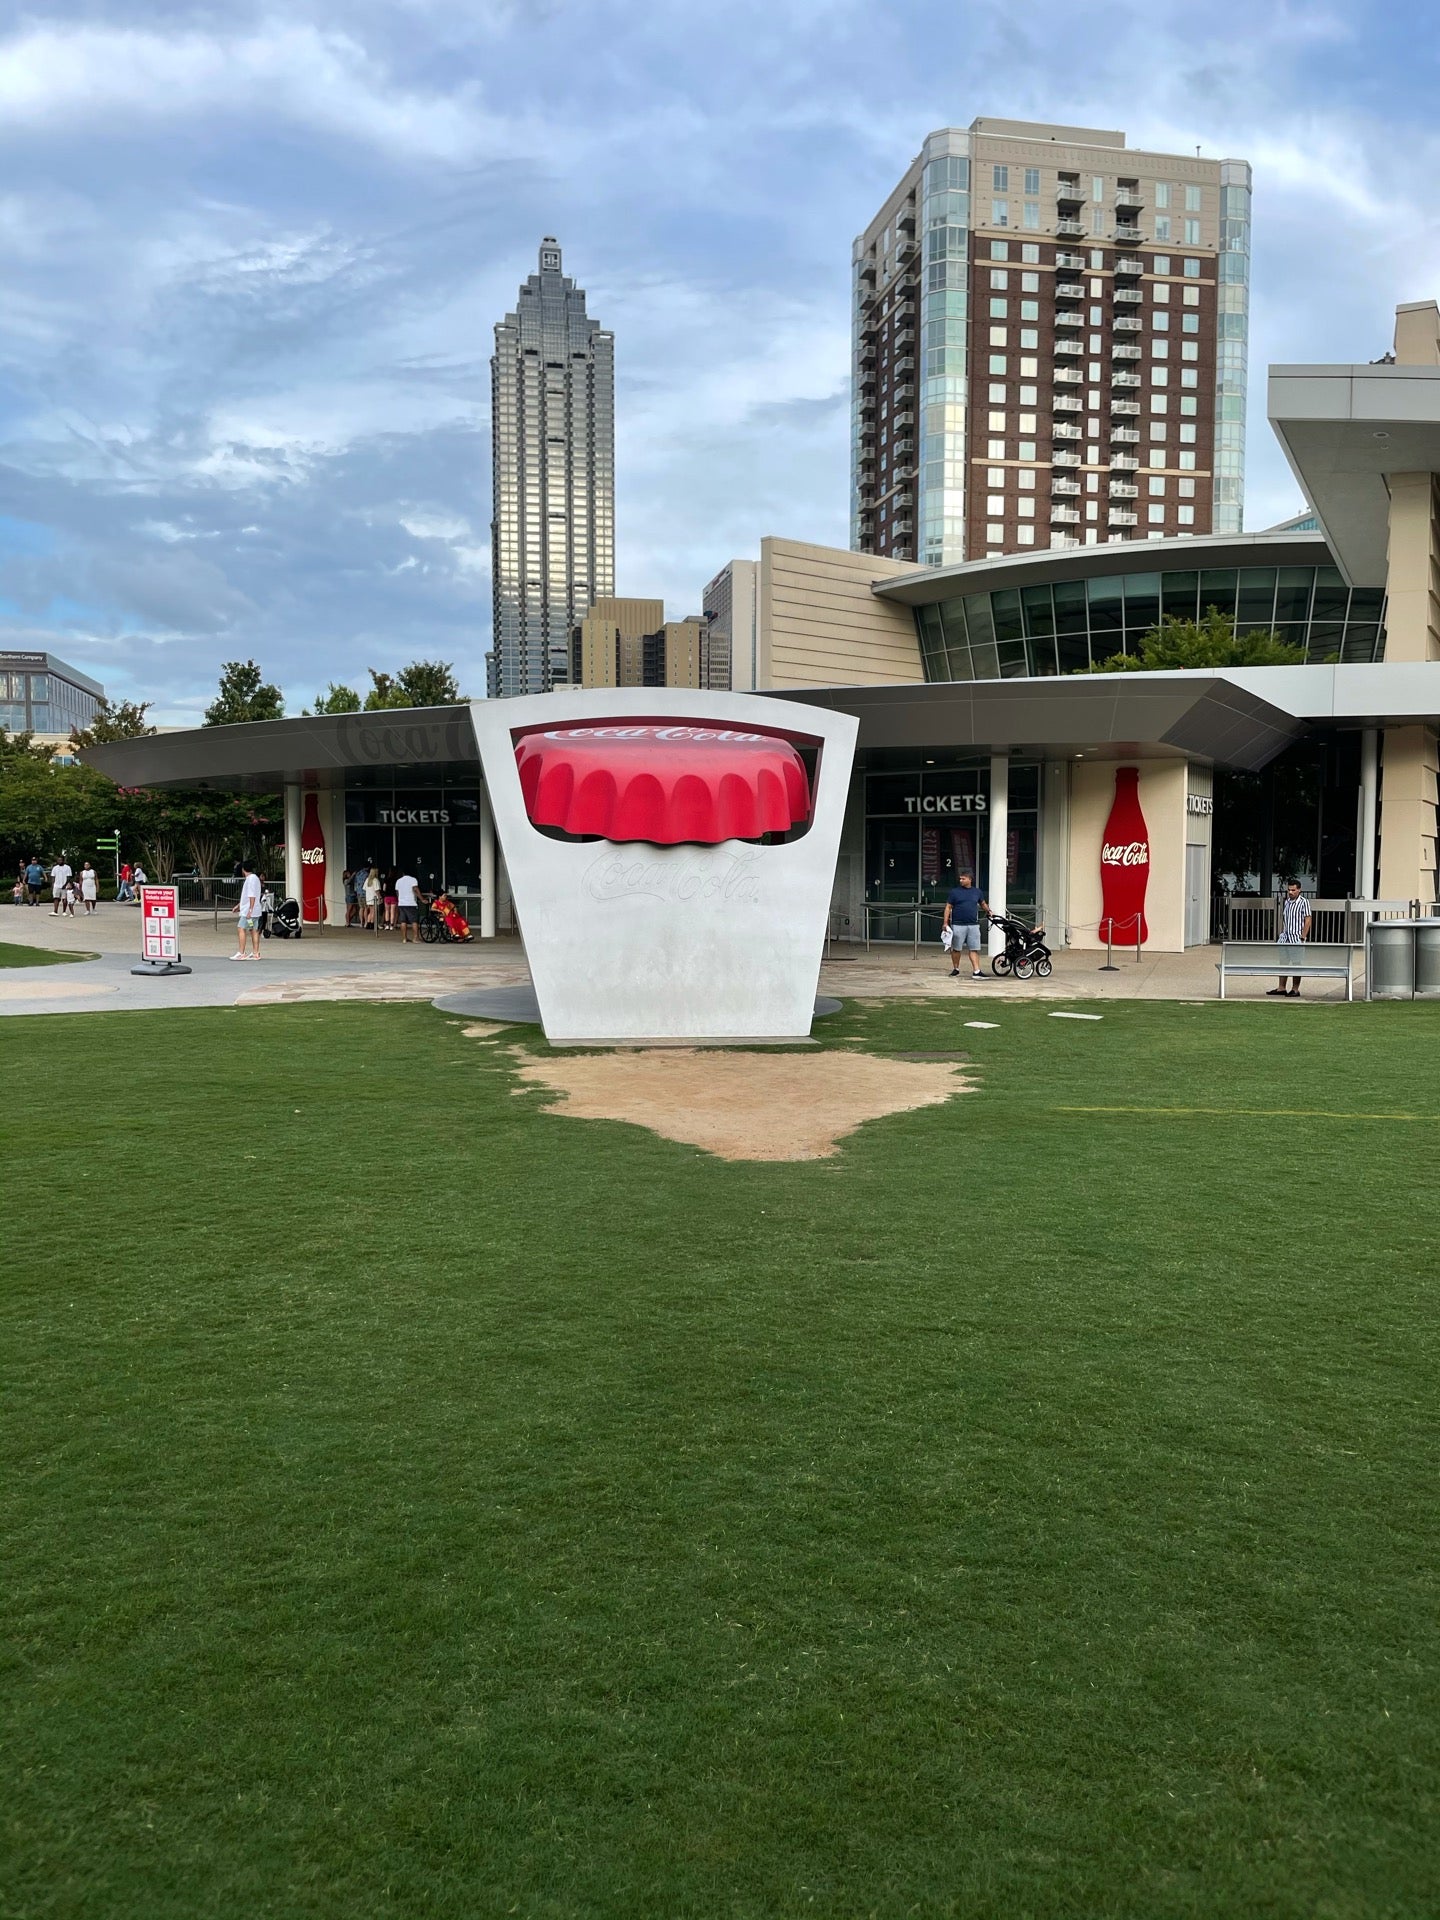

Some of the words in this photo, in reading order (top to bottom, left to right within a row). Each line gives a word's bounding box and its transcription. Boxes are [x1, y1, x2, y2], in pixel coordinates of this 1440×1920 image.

[904, 794, 986, 813] TICKETS
[1189, 795, 1213, 814] TICKETS
[380, 809, 450, 823] TICKETS
[889, 859, 895, 867] 3
[946, 858, 952, 867] 2
[1102, 842, 1148, 866] Coca-Cola
[581, 850, 767, 903] Coca-Cola
